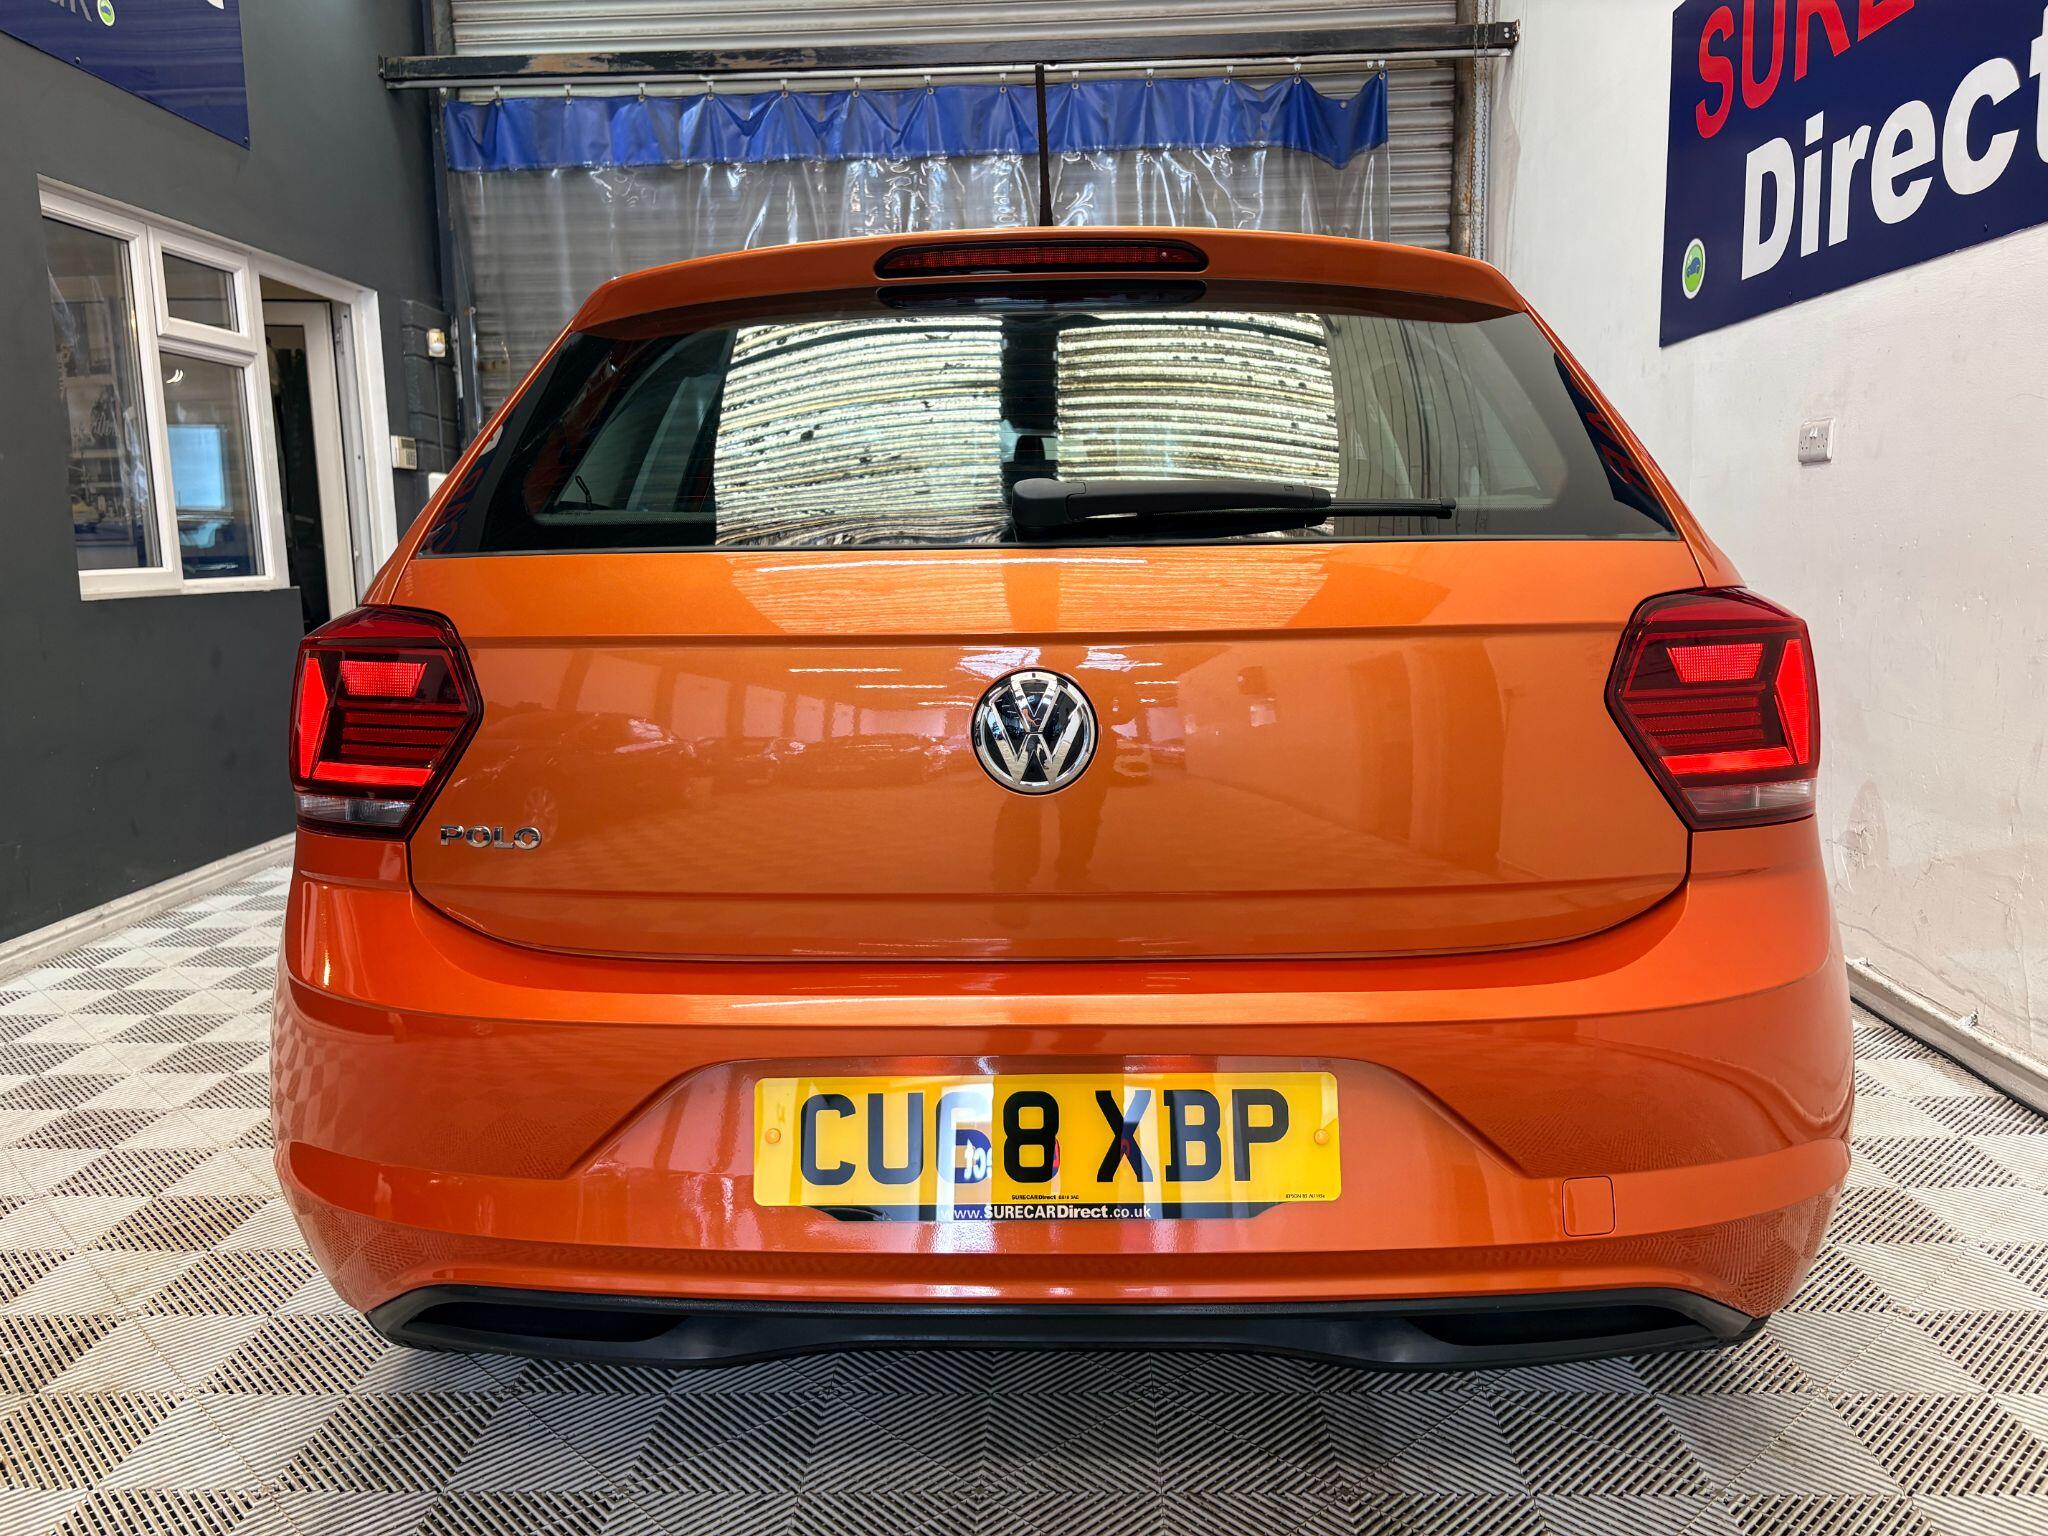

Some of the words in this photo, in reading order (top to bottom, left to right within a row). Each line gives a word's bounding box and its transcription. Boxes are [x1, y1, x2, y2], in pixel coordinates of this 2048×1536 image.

[1695, 0, 1915, 139] SUR
[440, 825, 542, 850] POLO
[800, 1091, 1060, 1185] CU68
[1095, 1089, 1289, 1182] XBP
[940, 1203, 1151, 1219] www.SURECARDirect.co.uk
